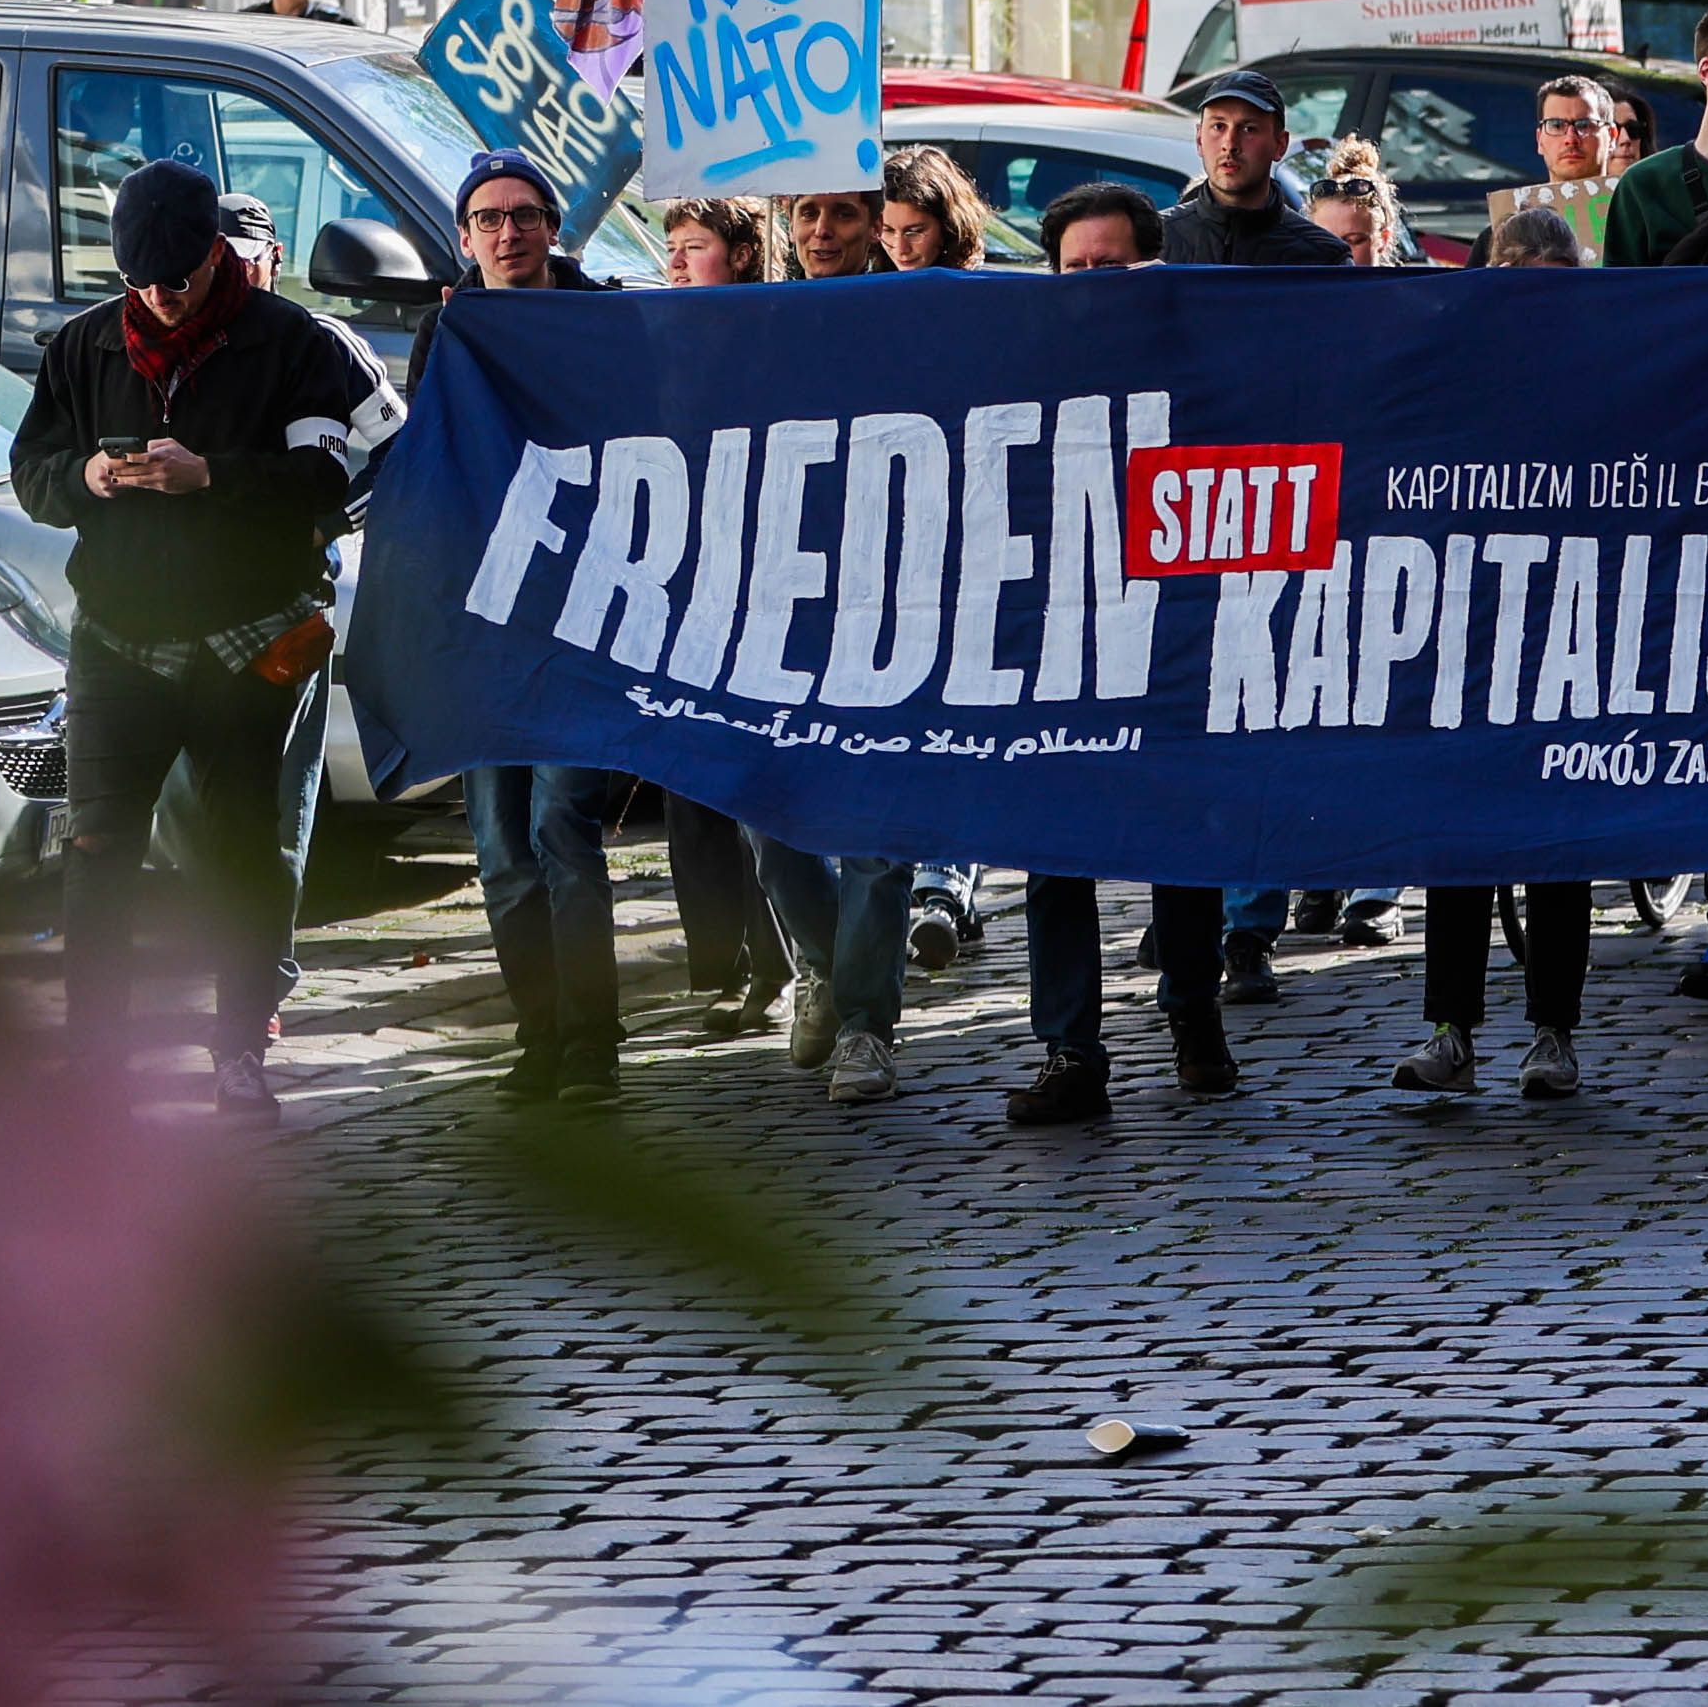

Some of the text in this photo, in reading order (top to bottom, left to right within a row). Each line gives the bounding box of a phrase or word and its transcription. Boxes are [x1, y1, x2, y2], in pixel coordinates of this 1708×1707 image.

[1519, 21, 1540, 37] Art
[1387, 462, 1574, 511] KAPITALIZM
[466, 390, 1171, 707] FRIEDEN
[1149, 465, 1318, 564] STATT
[1004, 726, 1142, 762] السلام
[1541, 729, 1656, 786] POKÓJ
